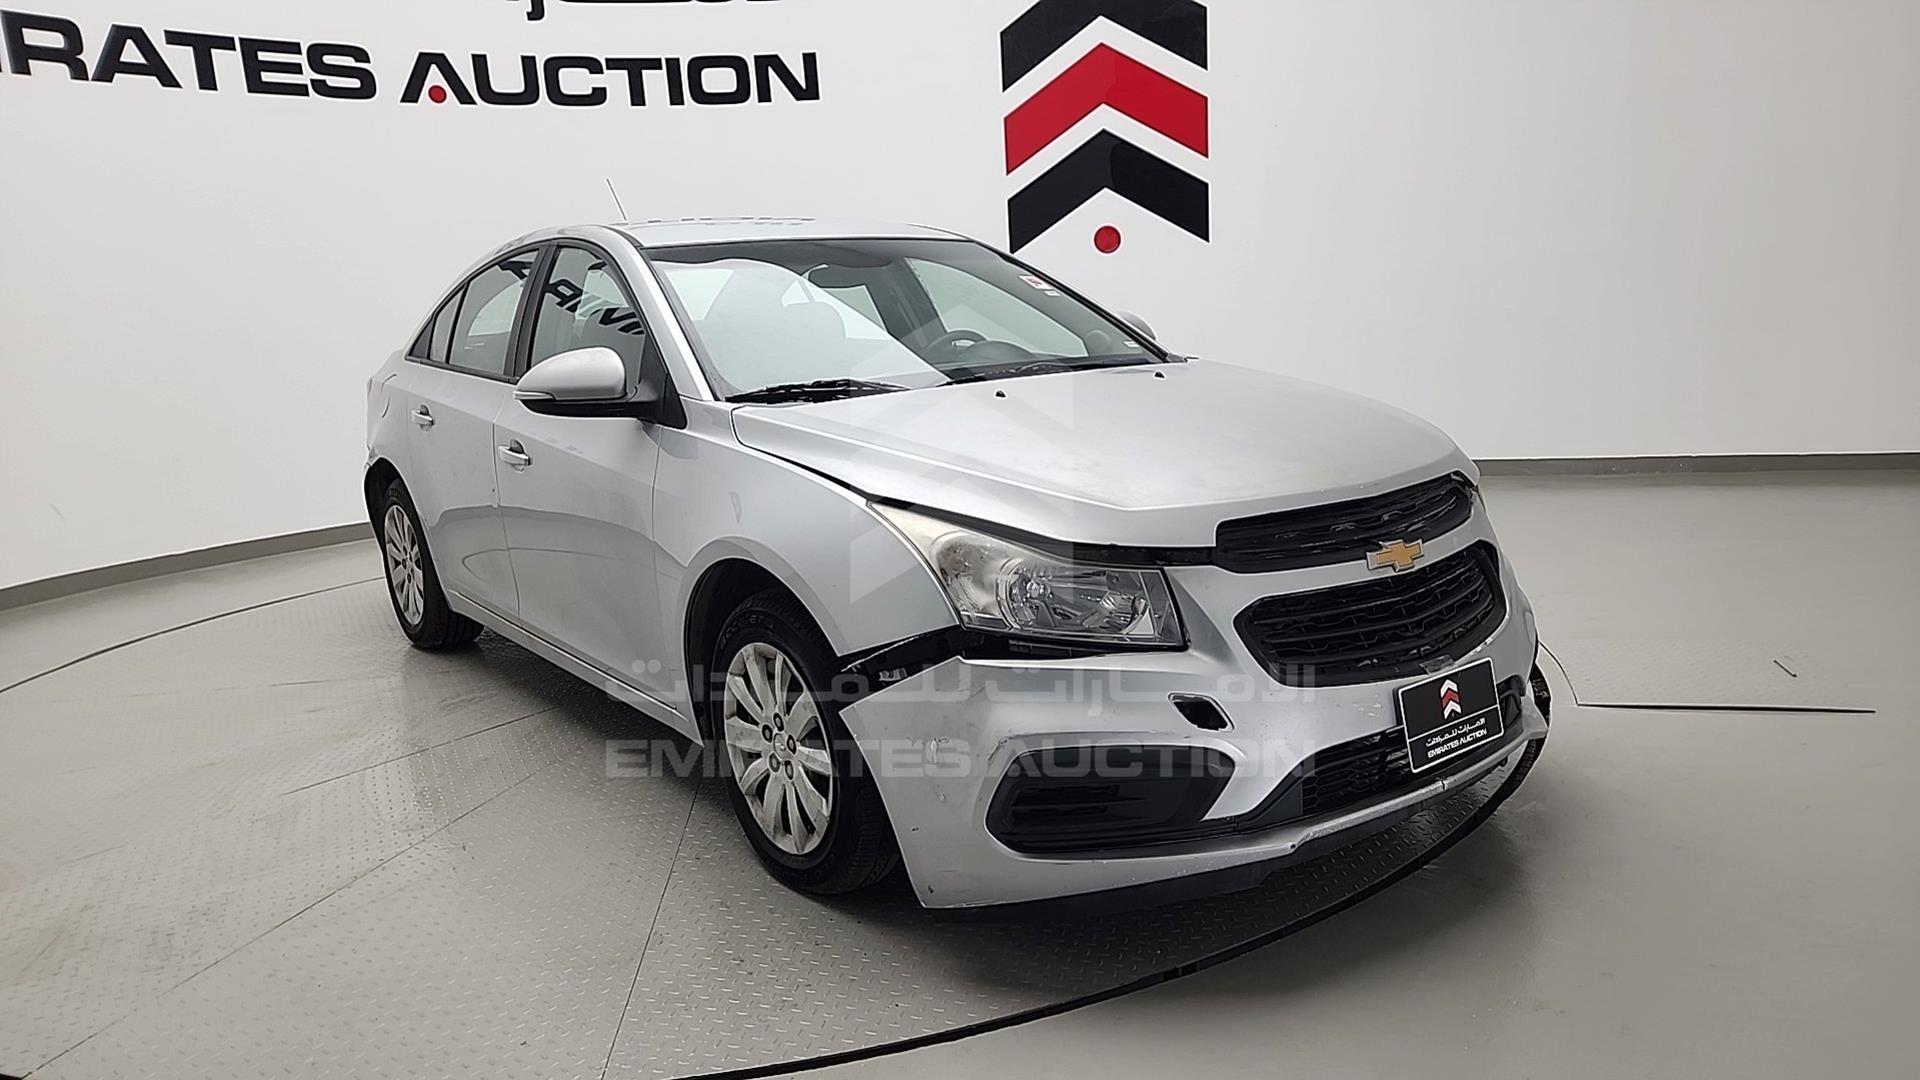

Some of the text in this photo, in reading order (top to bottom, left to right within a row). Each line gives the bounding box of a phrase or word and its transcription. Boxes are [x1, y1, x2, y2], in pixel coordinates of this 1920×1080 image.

[0, 9, 821, 107] RATES AUCTION
[1427, 728, 1488, 758] EMIRATES AUCTION
